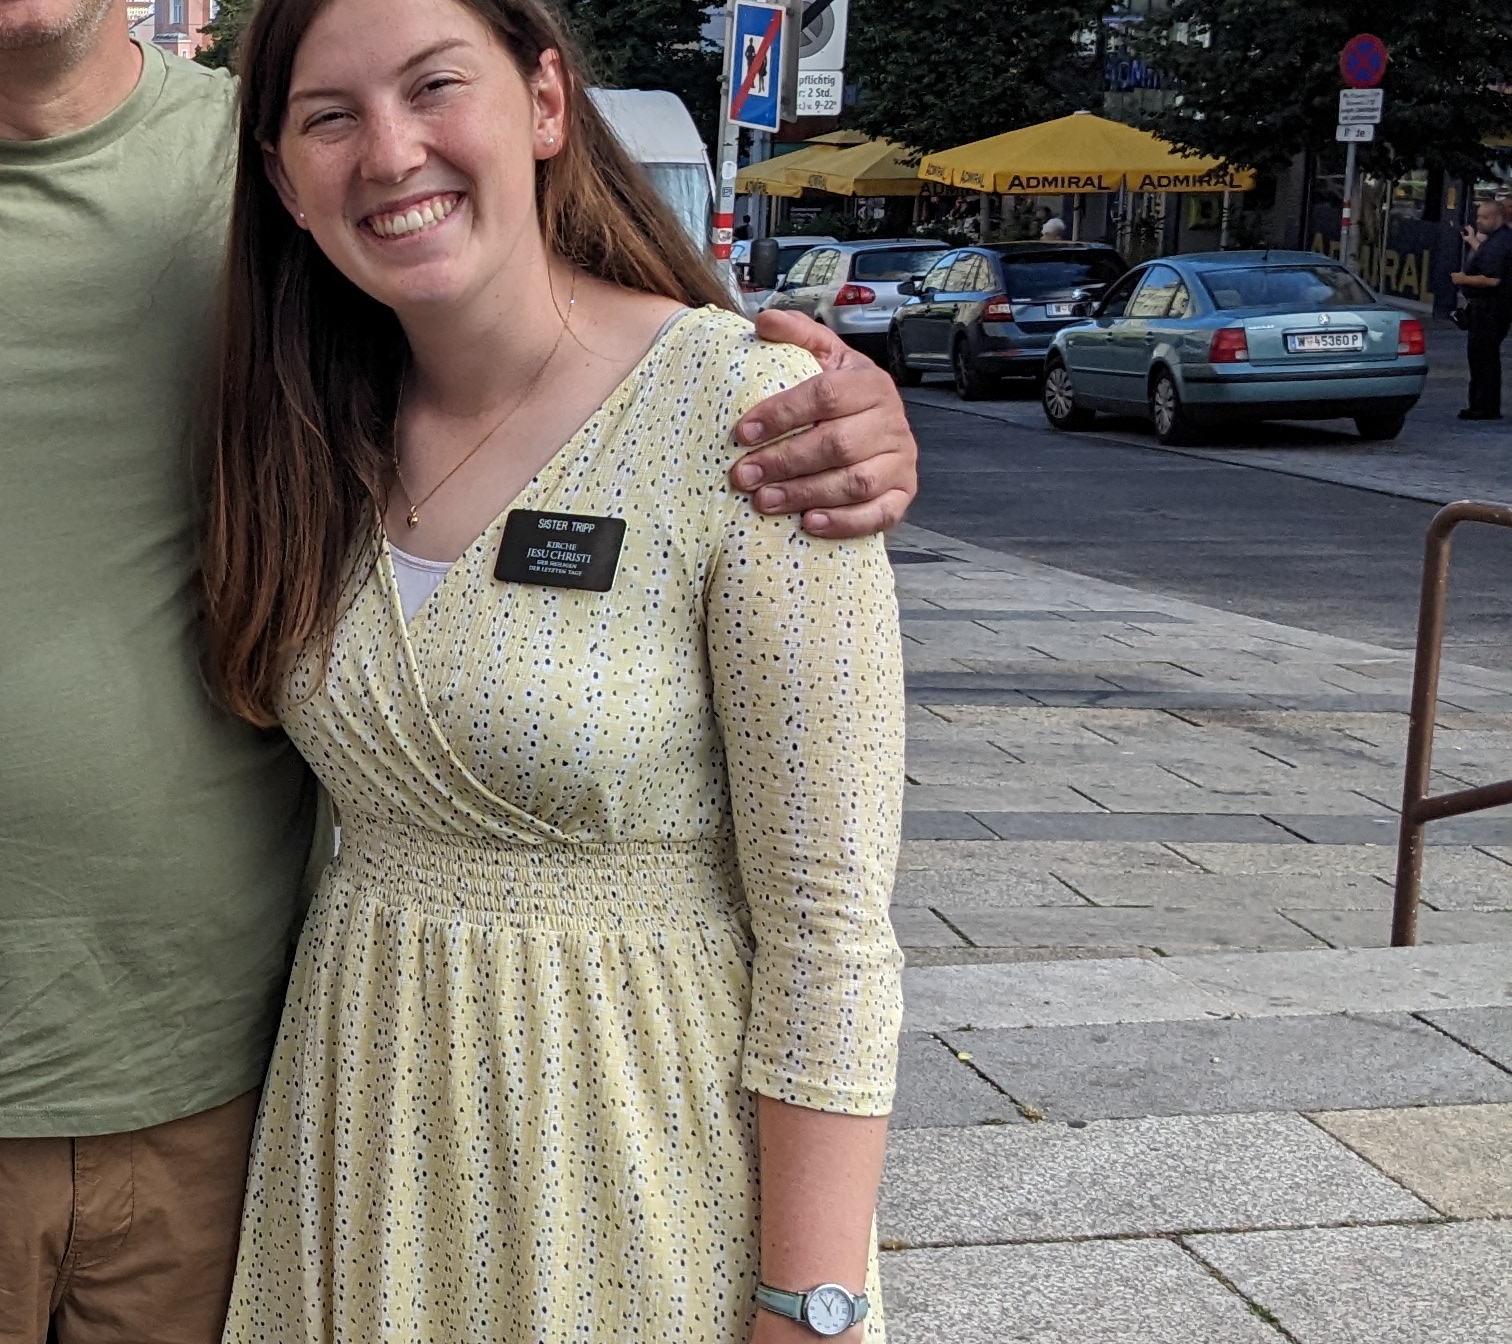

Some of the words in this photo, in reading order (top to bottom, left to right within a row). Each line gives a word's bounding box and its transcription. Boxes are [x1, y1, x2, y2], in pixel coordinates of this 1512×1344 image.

[808, 88, 813, 97] 2
[816, 88, 832, 97] Std.
[1007, 174, 1111, 192] ADMIRAL
[1139, 173, 1243, 191] ADMIRAL
[1296, 336, 1306, 347] W
[537, 518, 568, 531] SISTER
[572, 521, 596, 534] TRIPP
[546, 540, 577, 551] KIRCHE
[526, 547, 550, 559] JESU
[550, 549, 592, 564] CHRISTI
